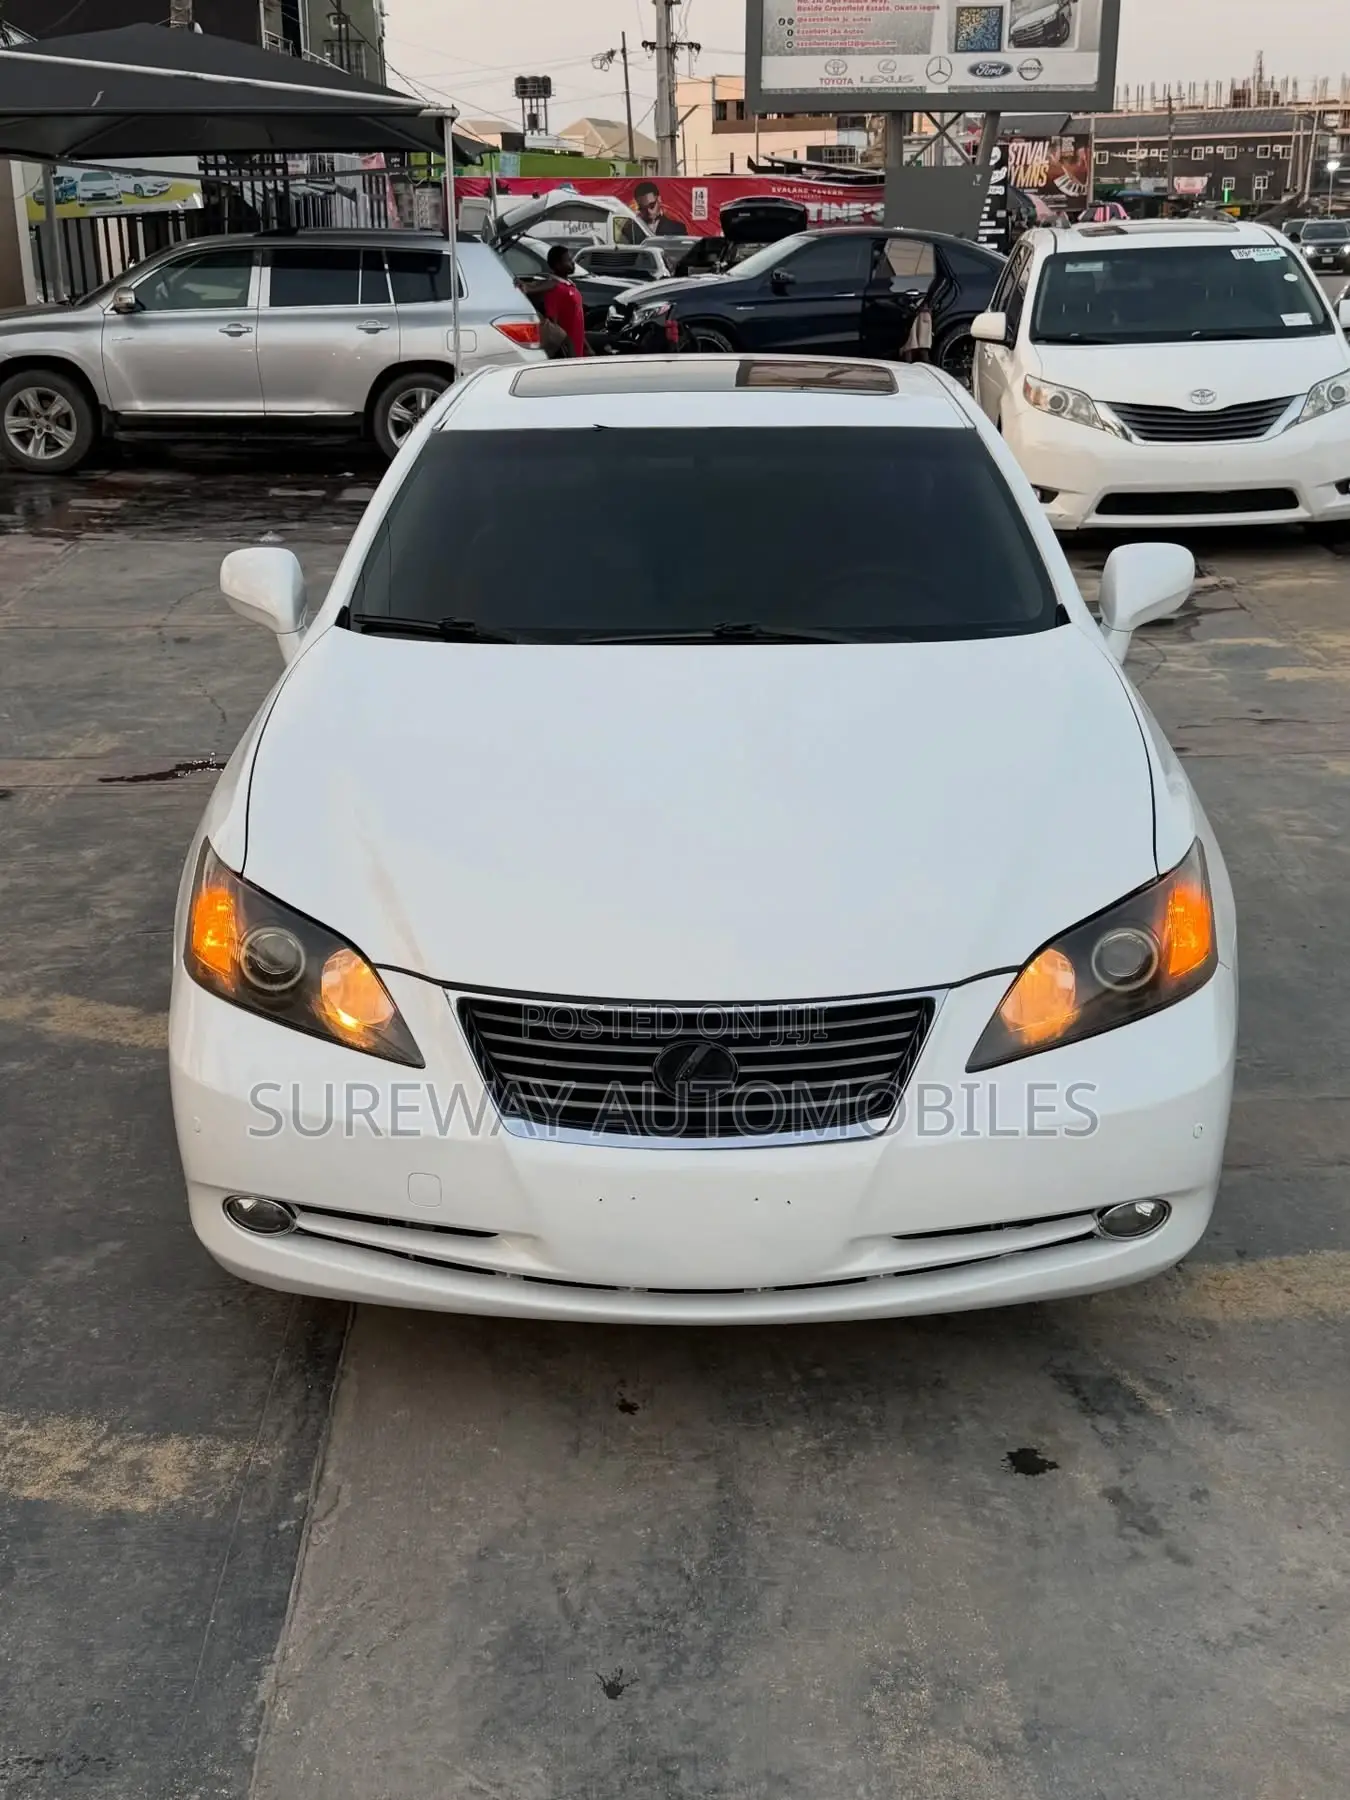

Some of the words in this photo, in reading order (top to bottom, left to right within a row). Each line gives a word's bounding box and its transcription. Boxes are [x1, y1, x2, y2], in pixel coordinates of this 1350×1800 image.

[976, 62, 1005, 78] Ford
[819, 77, 854, 85] TOYOTA
[860, 74, 915, 84] LEXUS
